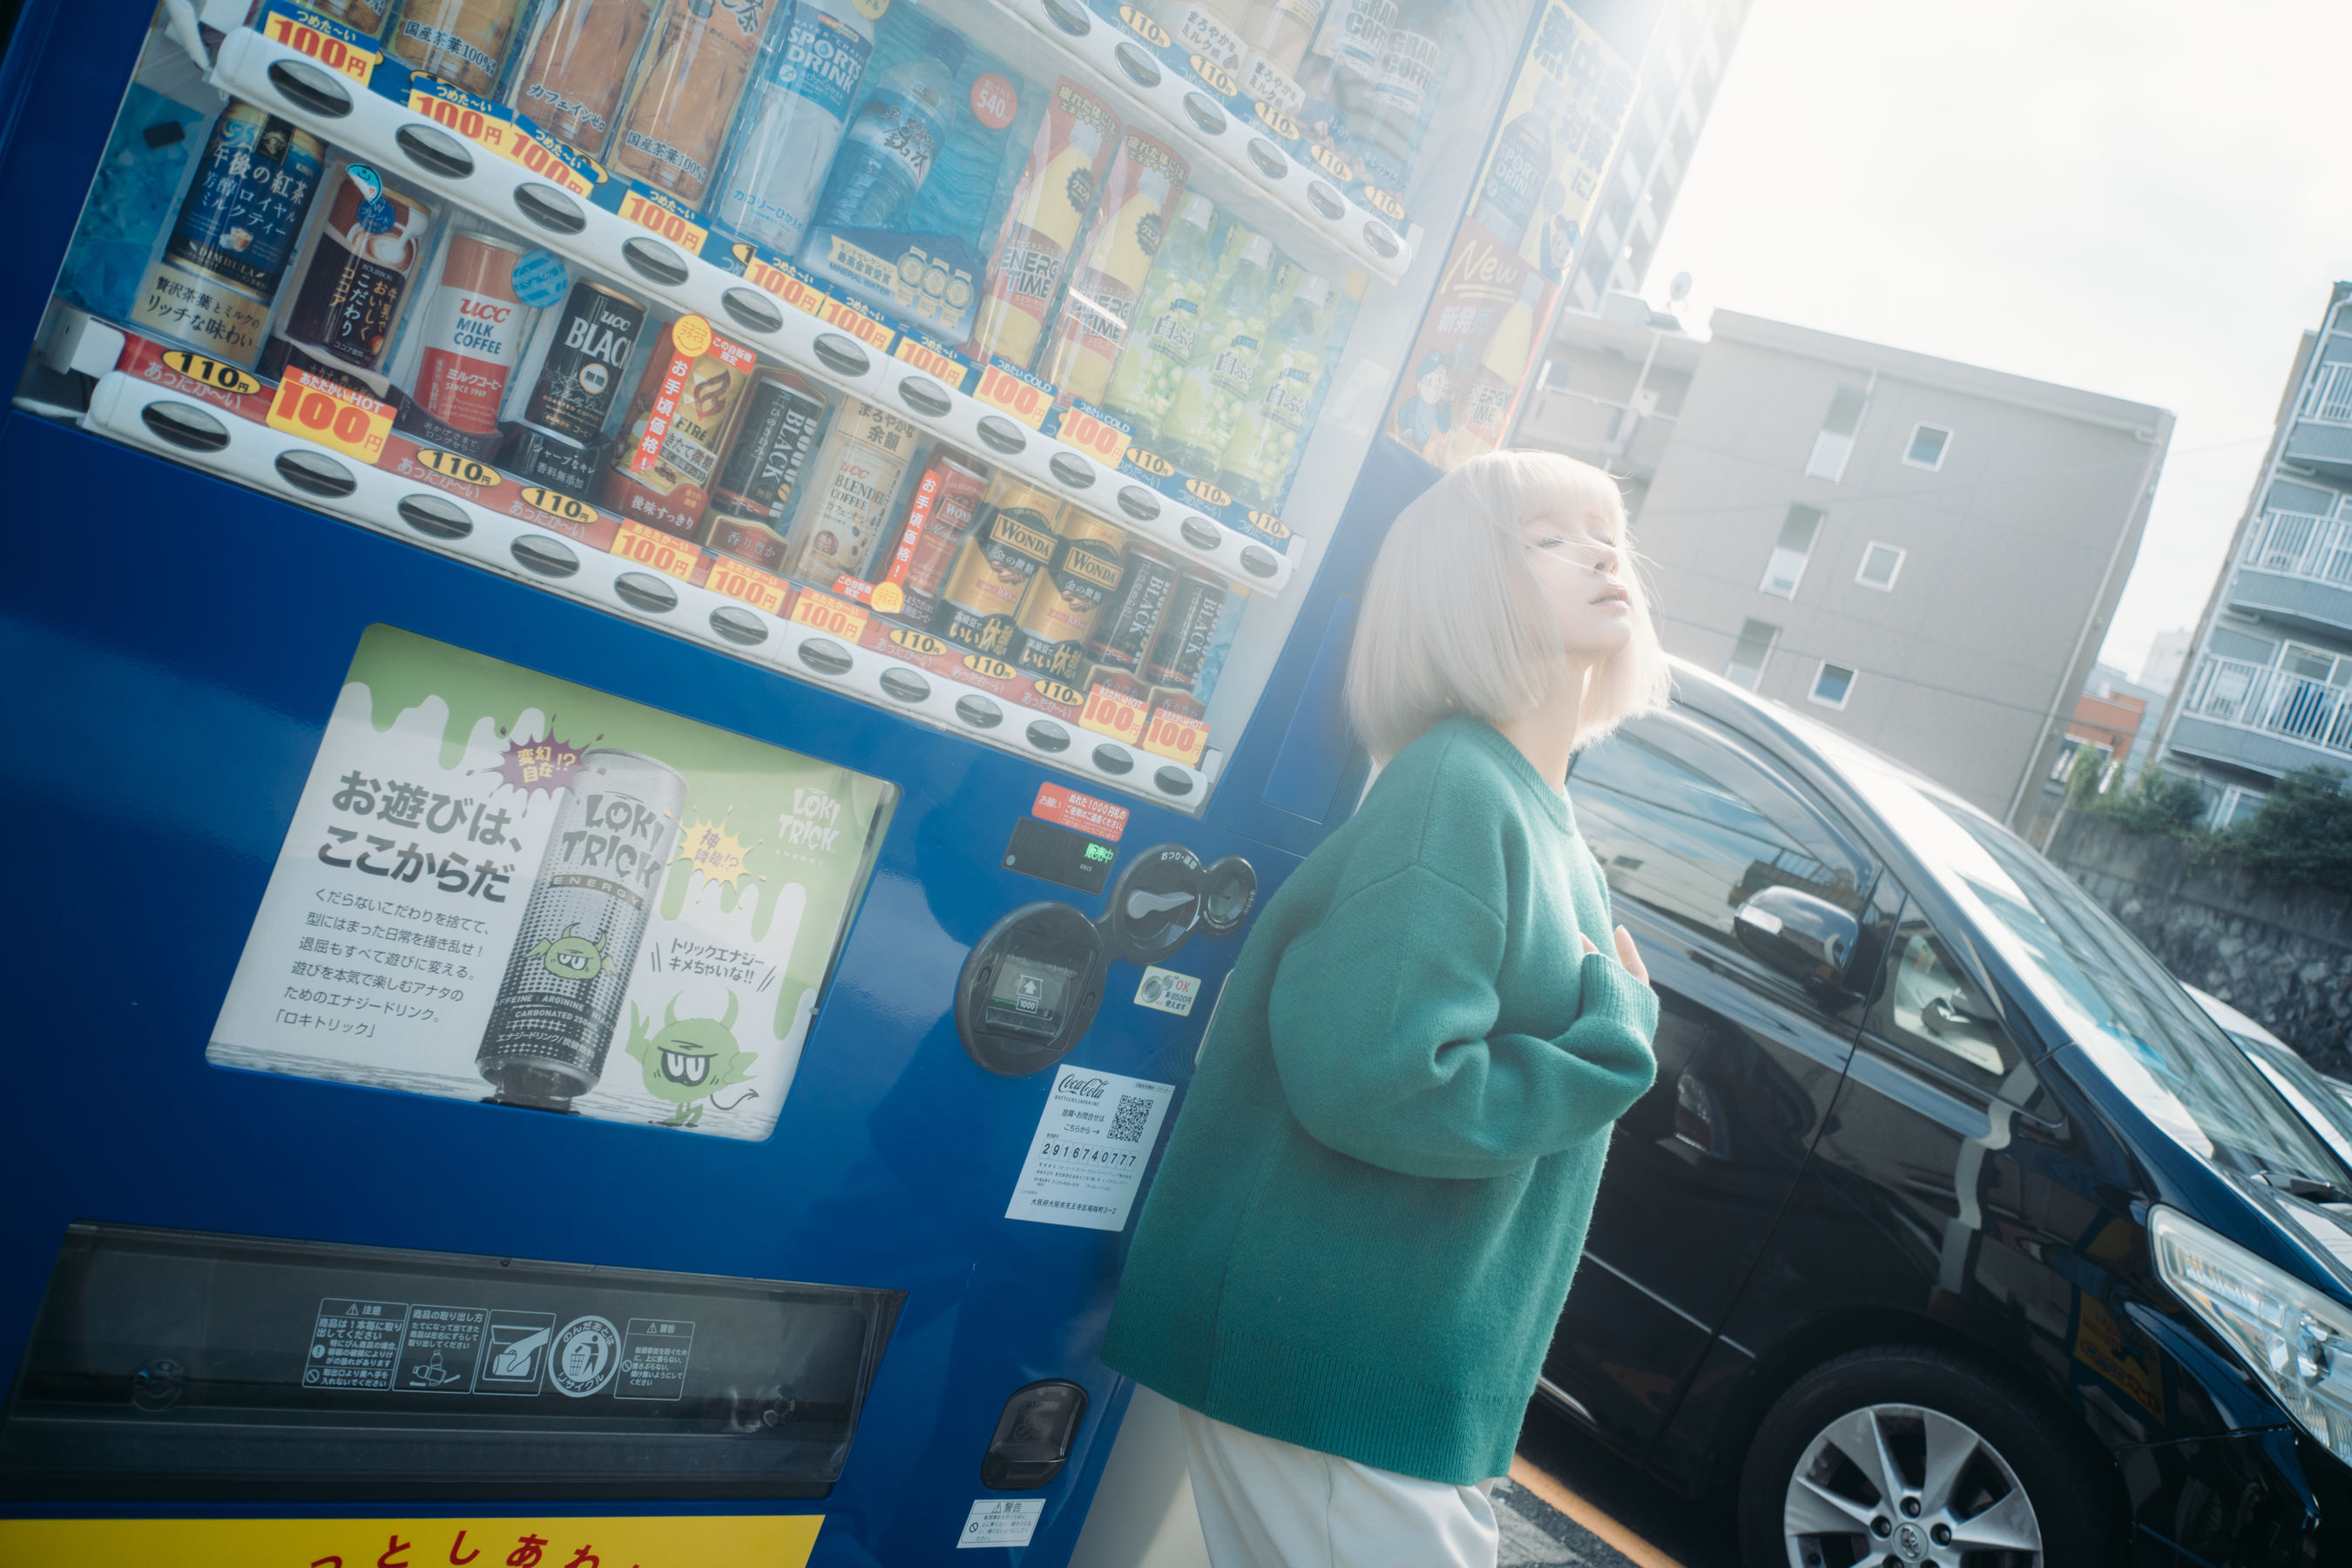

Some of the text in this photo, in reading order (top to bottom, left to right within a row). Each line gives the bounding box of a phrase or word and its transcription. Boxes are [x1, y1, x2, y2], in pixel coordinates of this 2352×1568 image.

[273, 17, 368, 78] 100円
[787, 26, 862, 80] SPORTS
[787, 44, 856, 95] DRINK
[415, 96, 503, 146] 100円
[526, 84, 606, 132] カフェインゼロ
[213, 141, 308, 206] 午後の紅茶
[1493, 159, 1537, 203] DRINK
[203, 171, 296, 223] 芳醇ロイヤル
[201, 191, 287, 237] ミルクティー
[630, 197, 700, 250] 100円
[828, 263, 891, 298] MINERAL WATER
[837, 250, 891, 285] 最高金賞受賞
[1440, 238, 1520, 297] New
[155, 275, 260, 329] 贅沢茶葉とミルクの
[328, 266, 355, 308] ココア
[752, 263, 816, 311] 100円
[1006, 268, 1050, 303] TIME
[146, 294, 254, 347] リッチな味わい
[342, 272, 370, 337] こだわり
[359, 280, 387, 341] おいしく
[456, 317, 495, 338] MILK
[827, 302, 887, 350] 100円
[453, 332, 504, 355] COFFEE
[712, 336, 754, 363] この自販機
[720, 350, 739, 367] 限定
[180, 352, 250, 393] 110円
[445, 368, 504, 391] ミルクコーヒー
[584, 369, 606, 388] 無糖
[904, 341, 959, 386] 100円
[299, 372, 348, 399] あたたかい
[348, 392, 384, 414] HOT
[444, 382, 469, 394] SINCE
[978, 365, 1045, 422] 100円
[1024, 372, 1053, 392] COLD
[275, 381, 383, 454] 100円
[675, 417, 707, 443] FIRE
[858, 402, 915, 440] まろやかな
[1104, 414, 1131, 433] COLD
[760, 408, 806, 484] BLACK
[1062, 408, 1123, 463] 100円
[429, 452, 493, 486] 110円
[532, 442, 597, 475] シャープなキレ
[1135, 449, 1168, 476] 110円
[536, 463, 585, 489] 香料無添加
[834, 472, 889, 507] BLENDED
[1193, 479, 1227, 506] 110円
[535, 488, 590, 523] 110円
[631, 495, 694, 531] 後味すっきり
[731, 496, 760, 514] コーヒー
[830, 487, 868, 510] COFFEE
[1000, 520, 1051, 557] WONDA
[1255, 512, 1286, 537] 110円
[620, 534, 690, 582] 100円
[725, 531, 776, 559] 香り豊か
[993, 549, 1035, 575] 金の微糖
[1071, 551, 1119, 585] WONDA
[713, 570, 779, 612] 100円
[1064, 579, 1103, 604] 金の微糖
[1129, 574, 1165, 637] BLACK
[800, 601, 859, 639] 100円
[1186, 596, 1219, 659] BLACK
[900, 629, 942, 656] 110円
[971, 655, 1011, 680] 110円
[1042, 680, 1079, 706] 110円
[1125, 697, 1144, 710] HOT
[1085, 693, 1140, 737] 100円
[1186, 717, 1204, 730] HOT
[1147, 717, 1202, 755] 100円
[517, 744, 552, 766] 変幻
[524, 760, 555, 783] 自在
[330, 768, 524, 854] お遊びは、
[585, 791, 666, 841] LOKI
[792, 787, 841, 821] LOKI
[1038, 794, 1062, 810] お願い
[1068, 793, 1126, 821] ぬれた1000円札の
[700, 828, 720, 848] 神
[778, 813, 841, 855] TRICK
[316, 824, 517, 903] ここからだ
[561, 830, 662, 889] TRICK
[774, 848, 827, 867] ENERGY
[1084, 842, 1114, 863] 販売中
[551, 874, 645, 909] ENERGY
[314, 887, 490, 936] くだらないこだわりを捨てて、
[298, 936, 476, 981] 退屈もすべて遊びに変える。
[670, 936, 766, 968] トリックエナジー
[290, 960, 464, 1003] 遊びを本気で楽しむアナタの
[1174, 980, 1192, 993] OK
[283, 984, 440, 1024] ためのエナジードリンク。
[537, 994, 585, 1011] ARGININE
[1019, 999, 1036, 1011] 1000
[1164, 999, 1187, 1011] 使えます
[276, 1008, 377, 1038] 「ロキトリック」
[515, 1008, 598, 1031] CARBONATED 250mL
[1058, 1073, 1110, 1100] Coca-Cola
[1064, 1124, 1091, 1135] こちらから
[318, 1318, 402, 1333] 商品は1本毎に取り
[362, 1305, 382, 1316] 注意
[412, 1308, 483, 1323] 商品の取り出し方
[316, 1328, 382, 1341] 出してください
[408, 1339, 470, 1349] 取り出してください
[409, 1330, 478, 1342] 商品は左右にずらして
[411, 1321, 480, 1334] たてになって出てきた
[563, 1321, 616, 1347] のんだあとは
[659, 1323, 677, 1335] 警告
[321, 1377, 388, 1388] 入れないでください
[558, 1372, 605, 1392] リサイクル
[629, 1378, 653, 1388] ください
[1004, 1502, 1024, 1513] 警告
